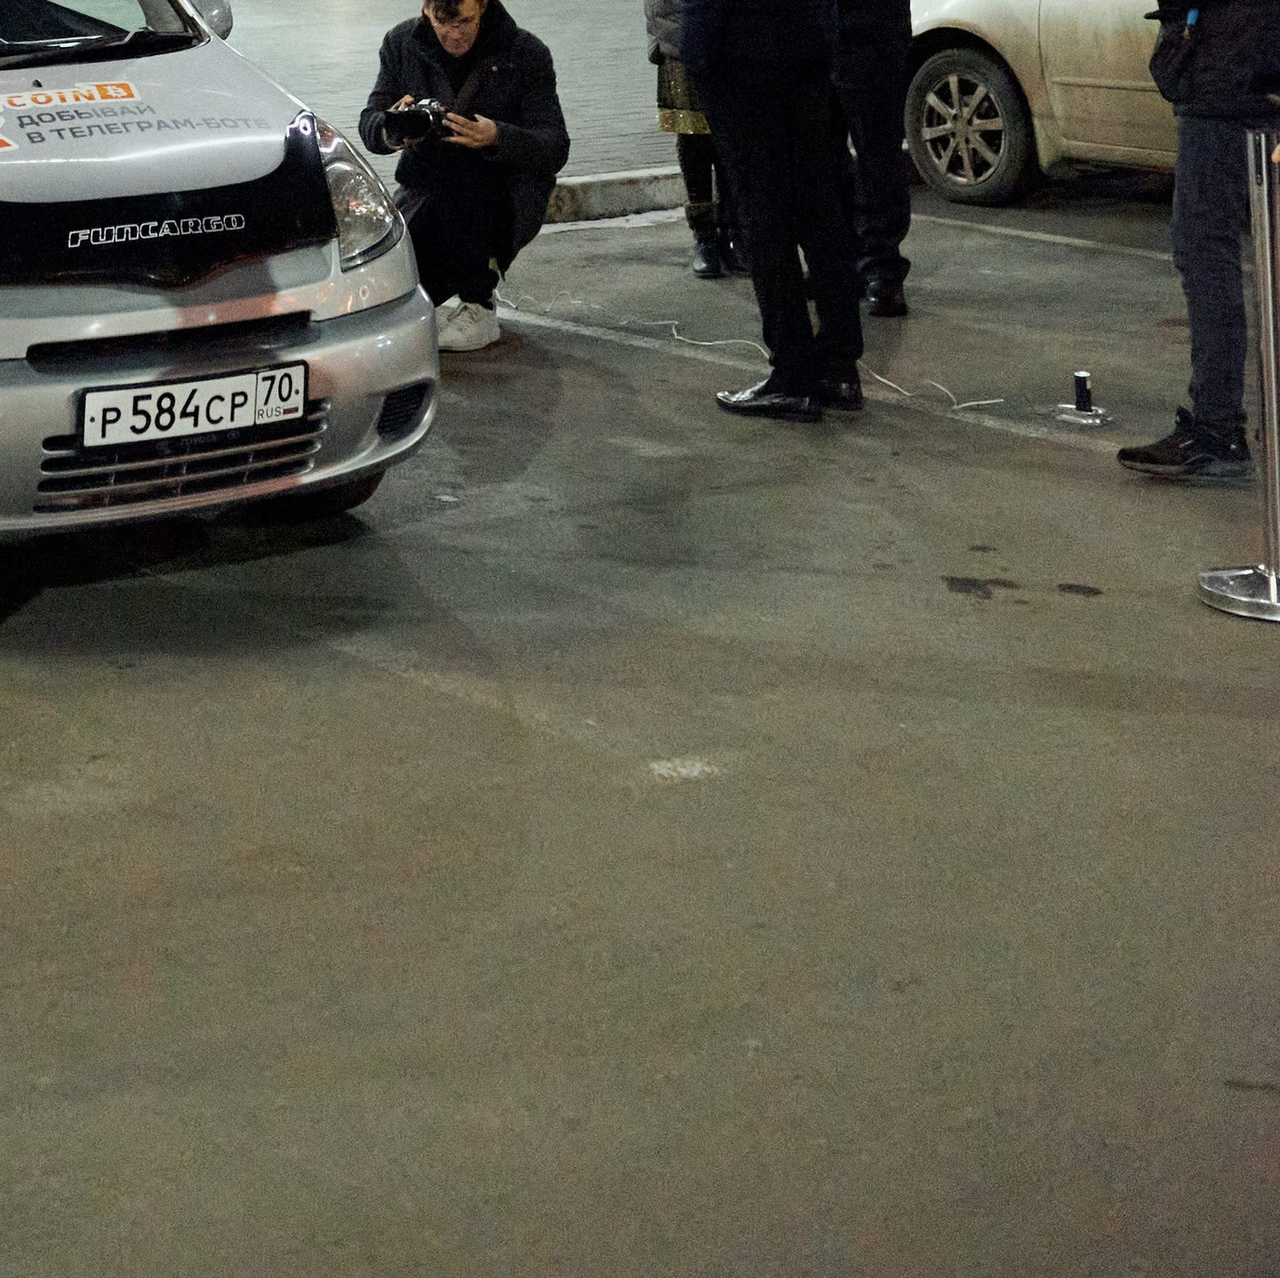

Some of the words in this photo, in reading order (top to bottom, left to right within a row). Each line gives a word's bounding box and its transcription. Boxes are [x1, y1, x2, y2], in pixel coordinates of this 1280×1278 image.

[15, 103, 157, 130] ДОБЫВАЙ
[25, 130, 46, 145] В
[49, 117, 270, 141] ТЕЛЕГРАМ-БОТЕ
[257, 405, 282, 419] RUS
